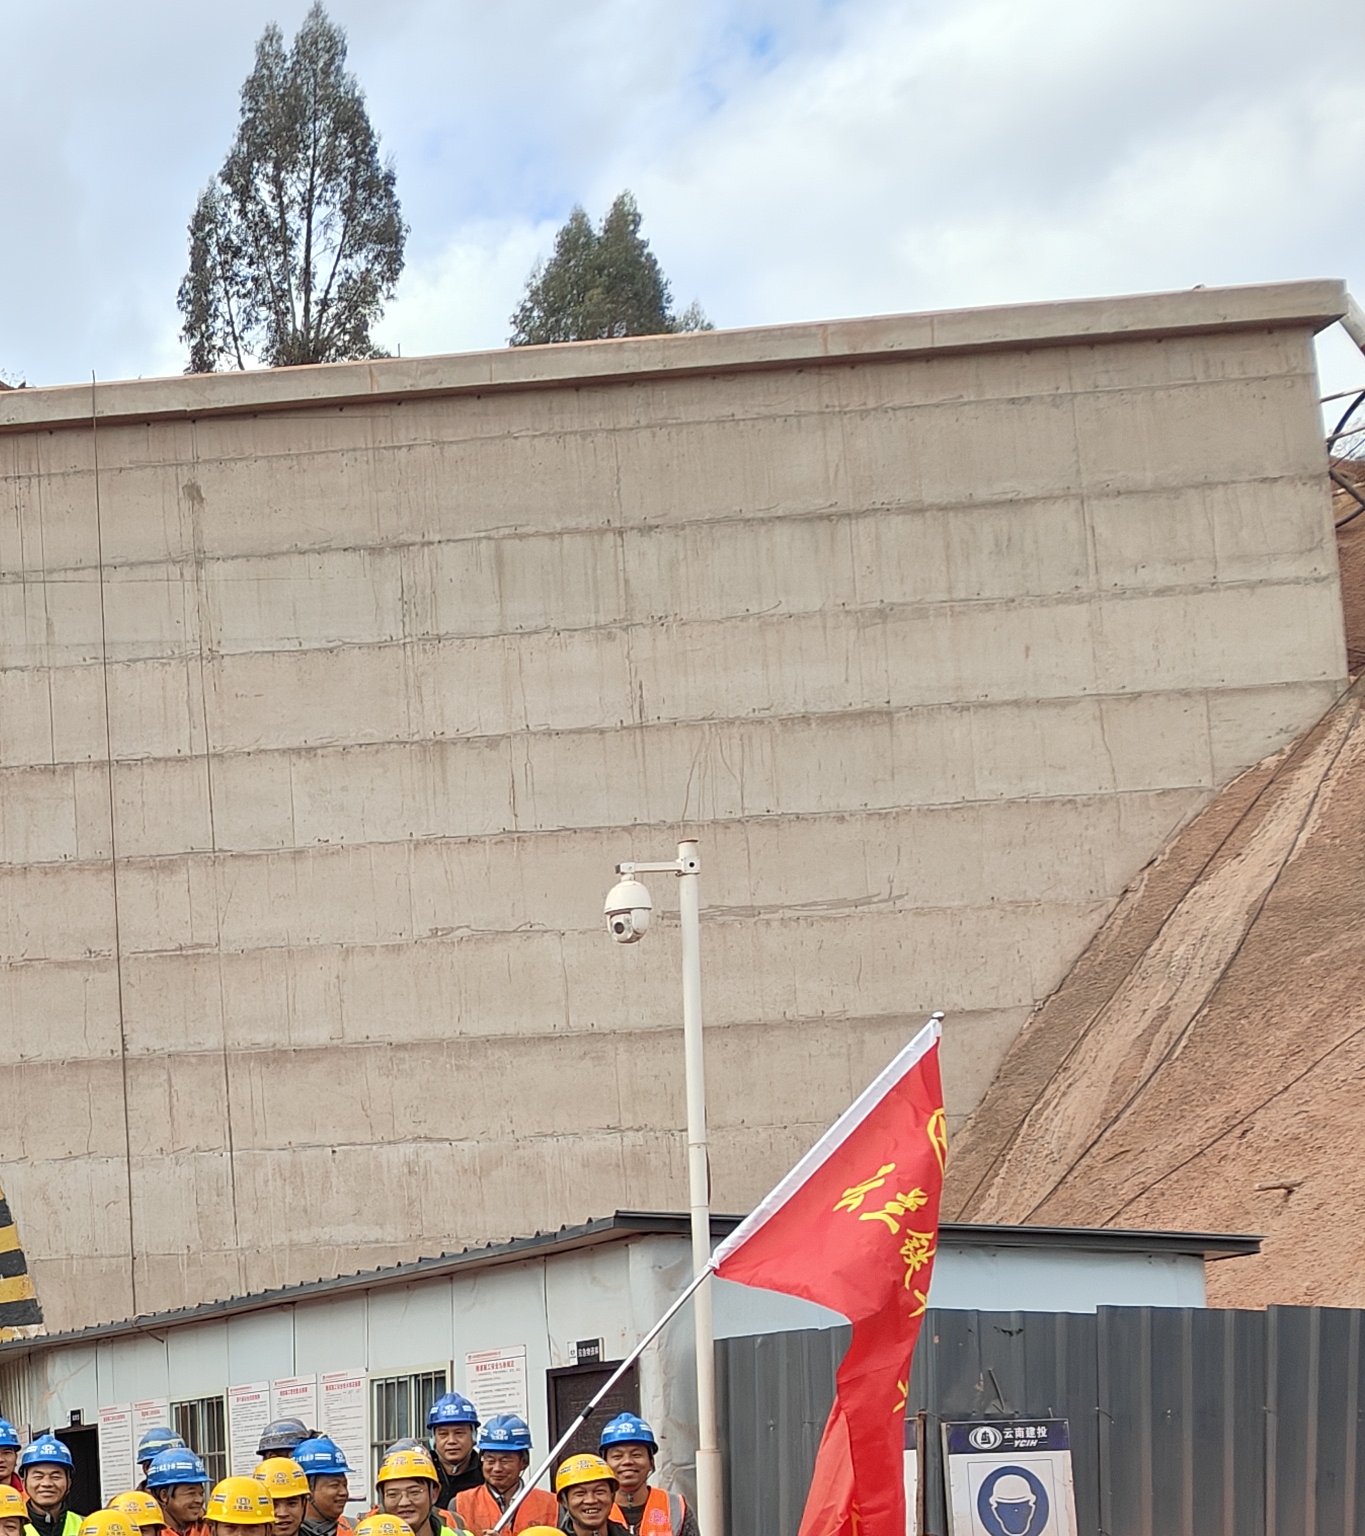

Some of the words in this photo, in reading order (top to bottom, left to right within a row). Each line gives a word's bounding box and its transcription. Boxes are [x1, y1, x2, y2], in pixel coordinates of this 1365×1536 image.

[1002, 1426, 1048, 1440] 云南建投
[1014, 1439, 1039, 1448] YCIH
